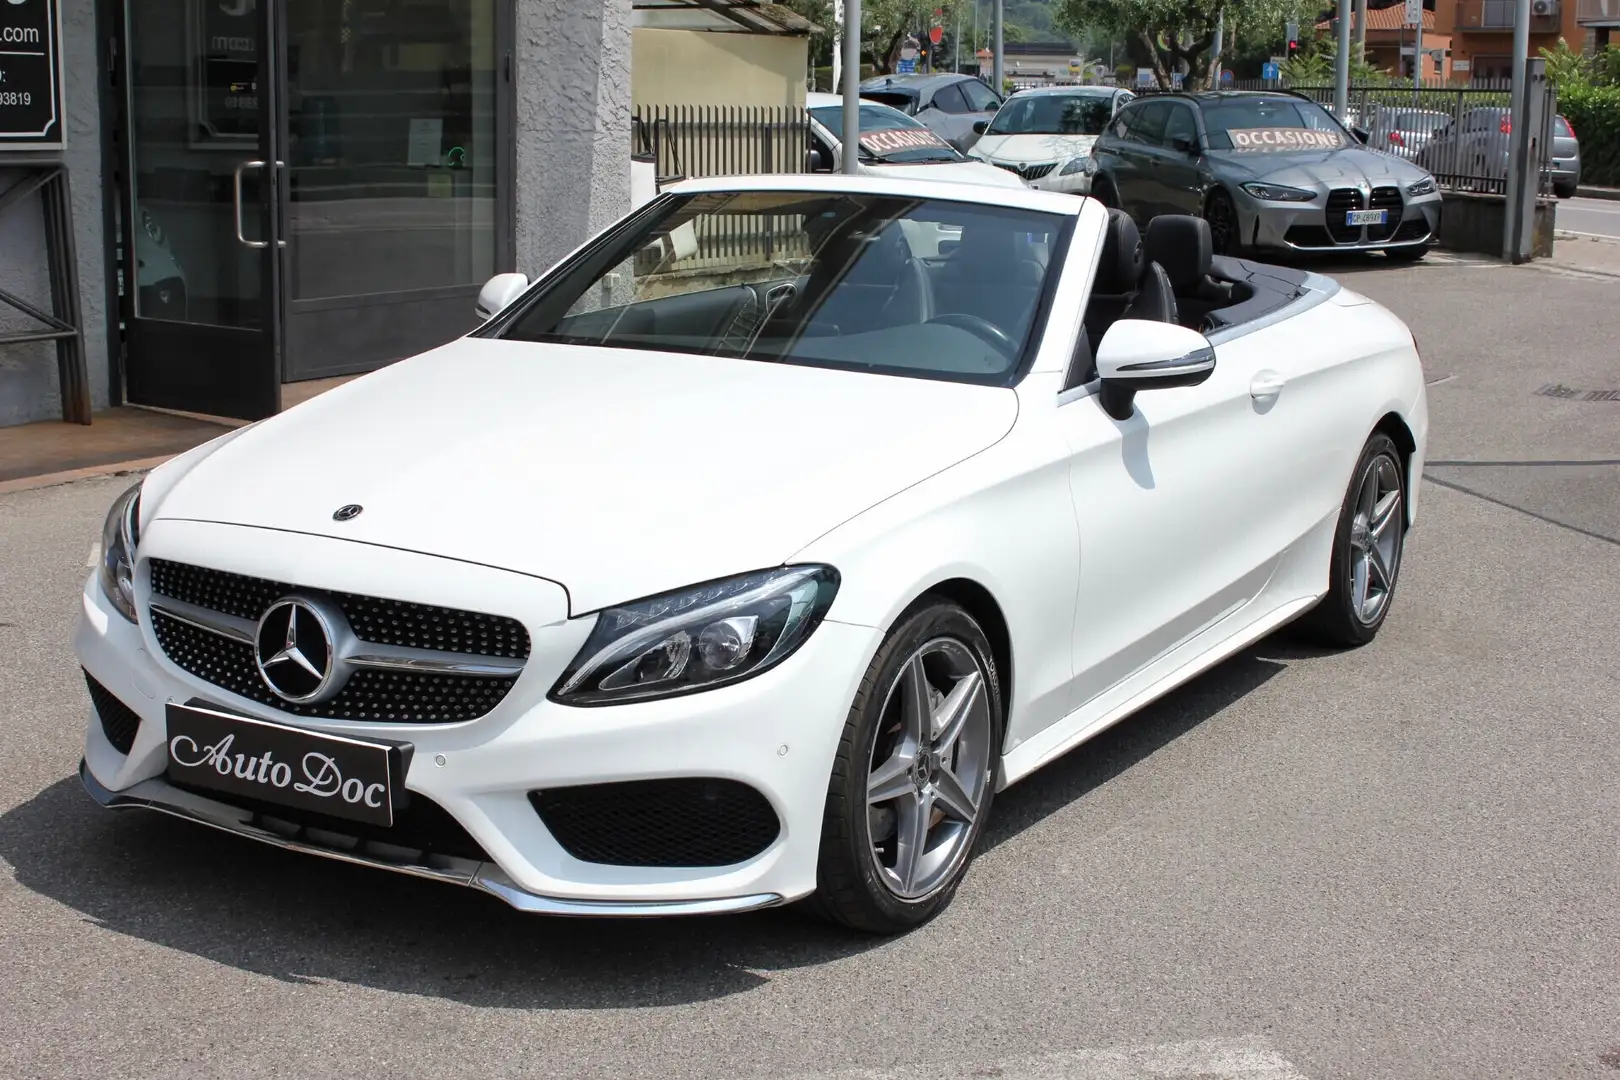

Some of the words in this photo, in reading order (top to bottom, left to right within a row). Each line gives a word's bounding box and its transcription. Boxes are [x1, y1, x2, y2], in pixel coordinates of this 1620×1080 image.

[1236, 131, 1339, 147] OCCASIONE
[170, 733, 292, 788] Auto
[293, 751, 386, 808] Doc
